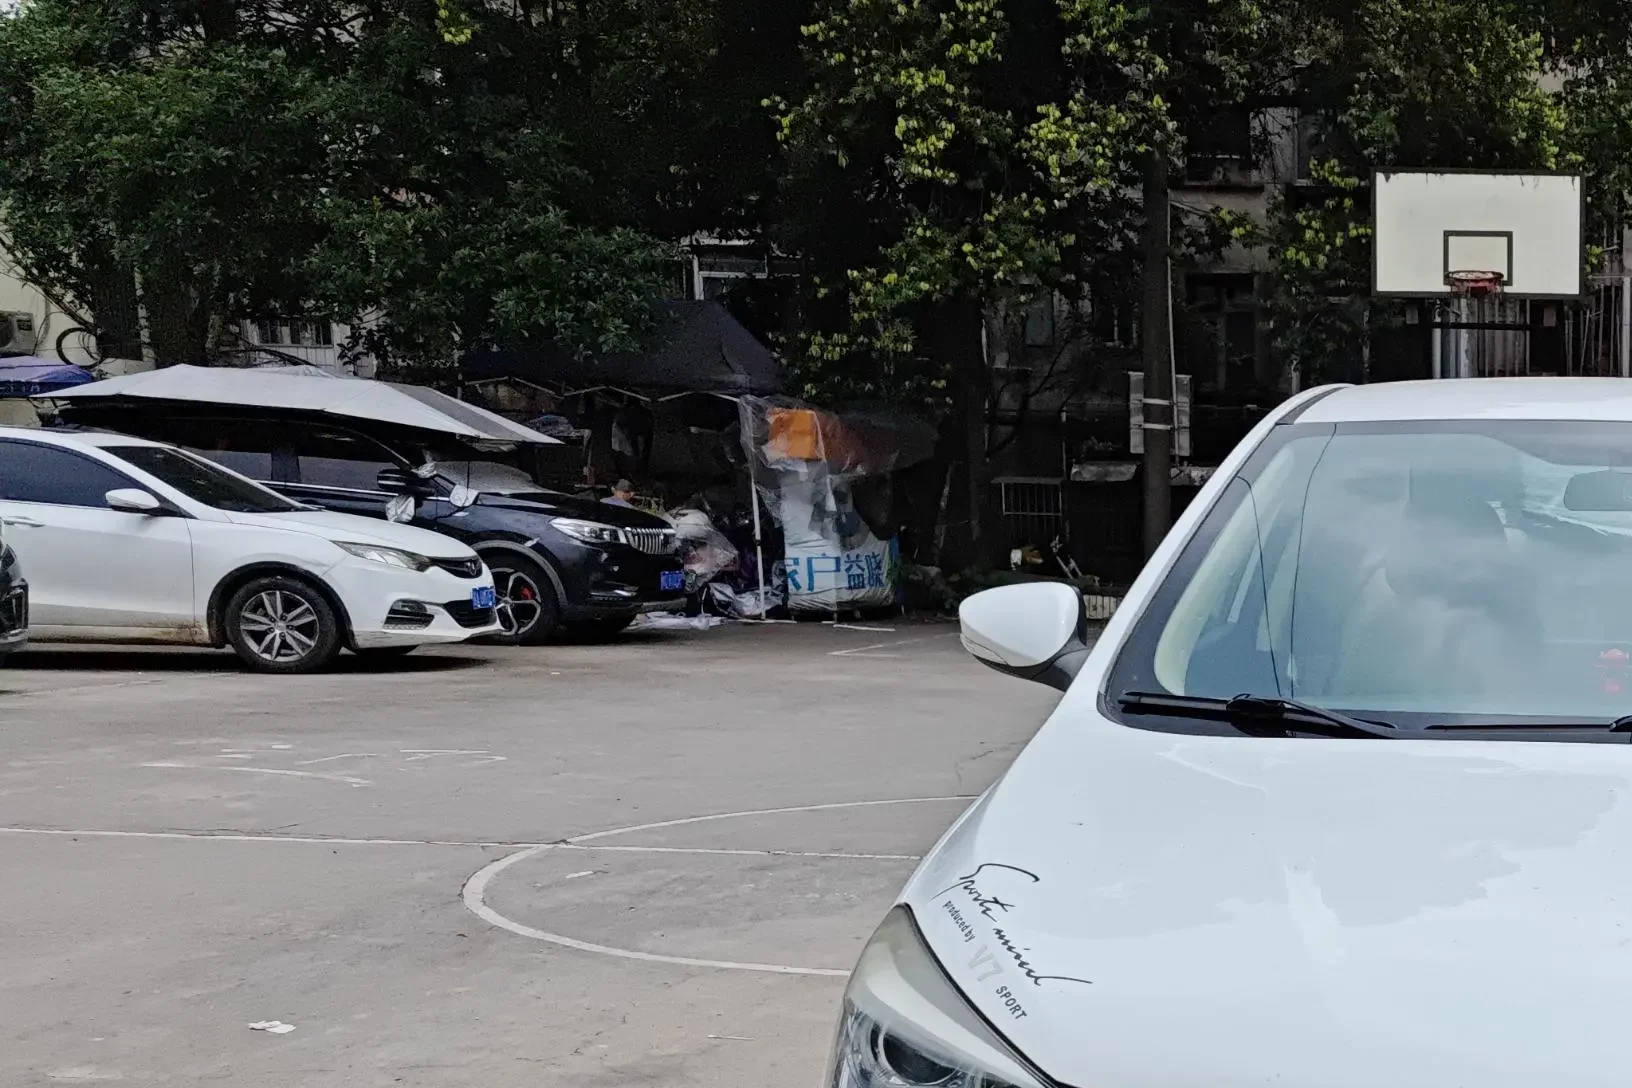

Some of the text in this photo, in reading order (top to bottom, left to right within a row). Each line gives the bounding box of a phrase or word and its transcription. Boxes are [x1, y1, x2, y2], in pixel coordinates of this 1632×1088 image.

[942, 900, 971, 935] produced
[967, 945, 1005, 983] V7
[995, 985, 1028, 1020] SPORT
